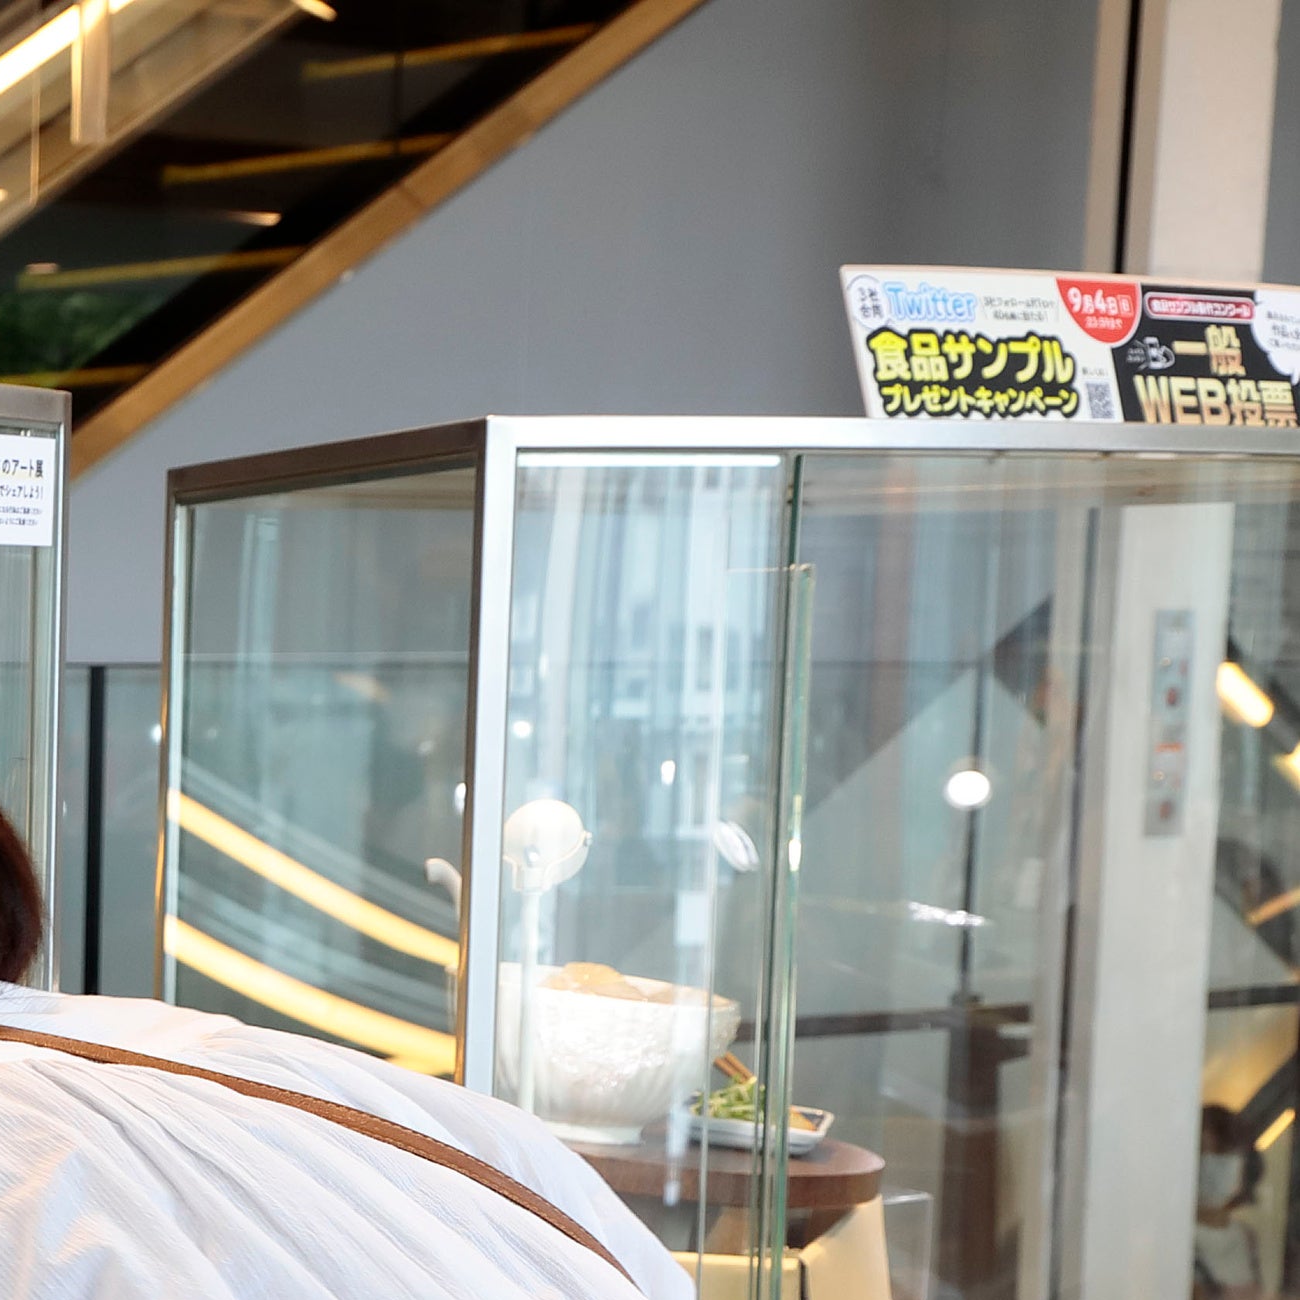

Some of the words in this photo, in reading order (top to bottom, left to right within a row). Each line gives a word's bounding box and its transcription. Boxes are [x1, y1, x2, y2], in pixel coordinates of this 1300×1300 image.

[885, 283, 976, 320] Twitter
[868, 332, 1074, 384] 食品サンプル
[1172, 325, 1246, 376] 一般
[880, 386, 1079, 417] プレゼントキャンペーン
[1133, 375, 1298, 427] WEB投票
